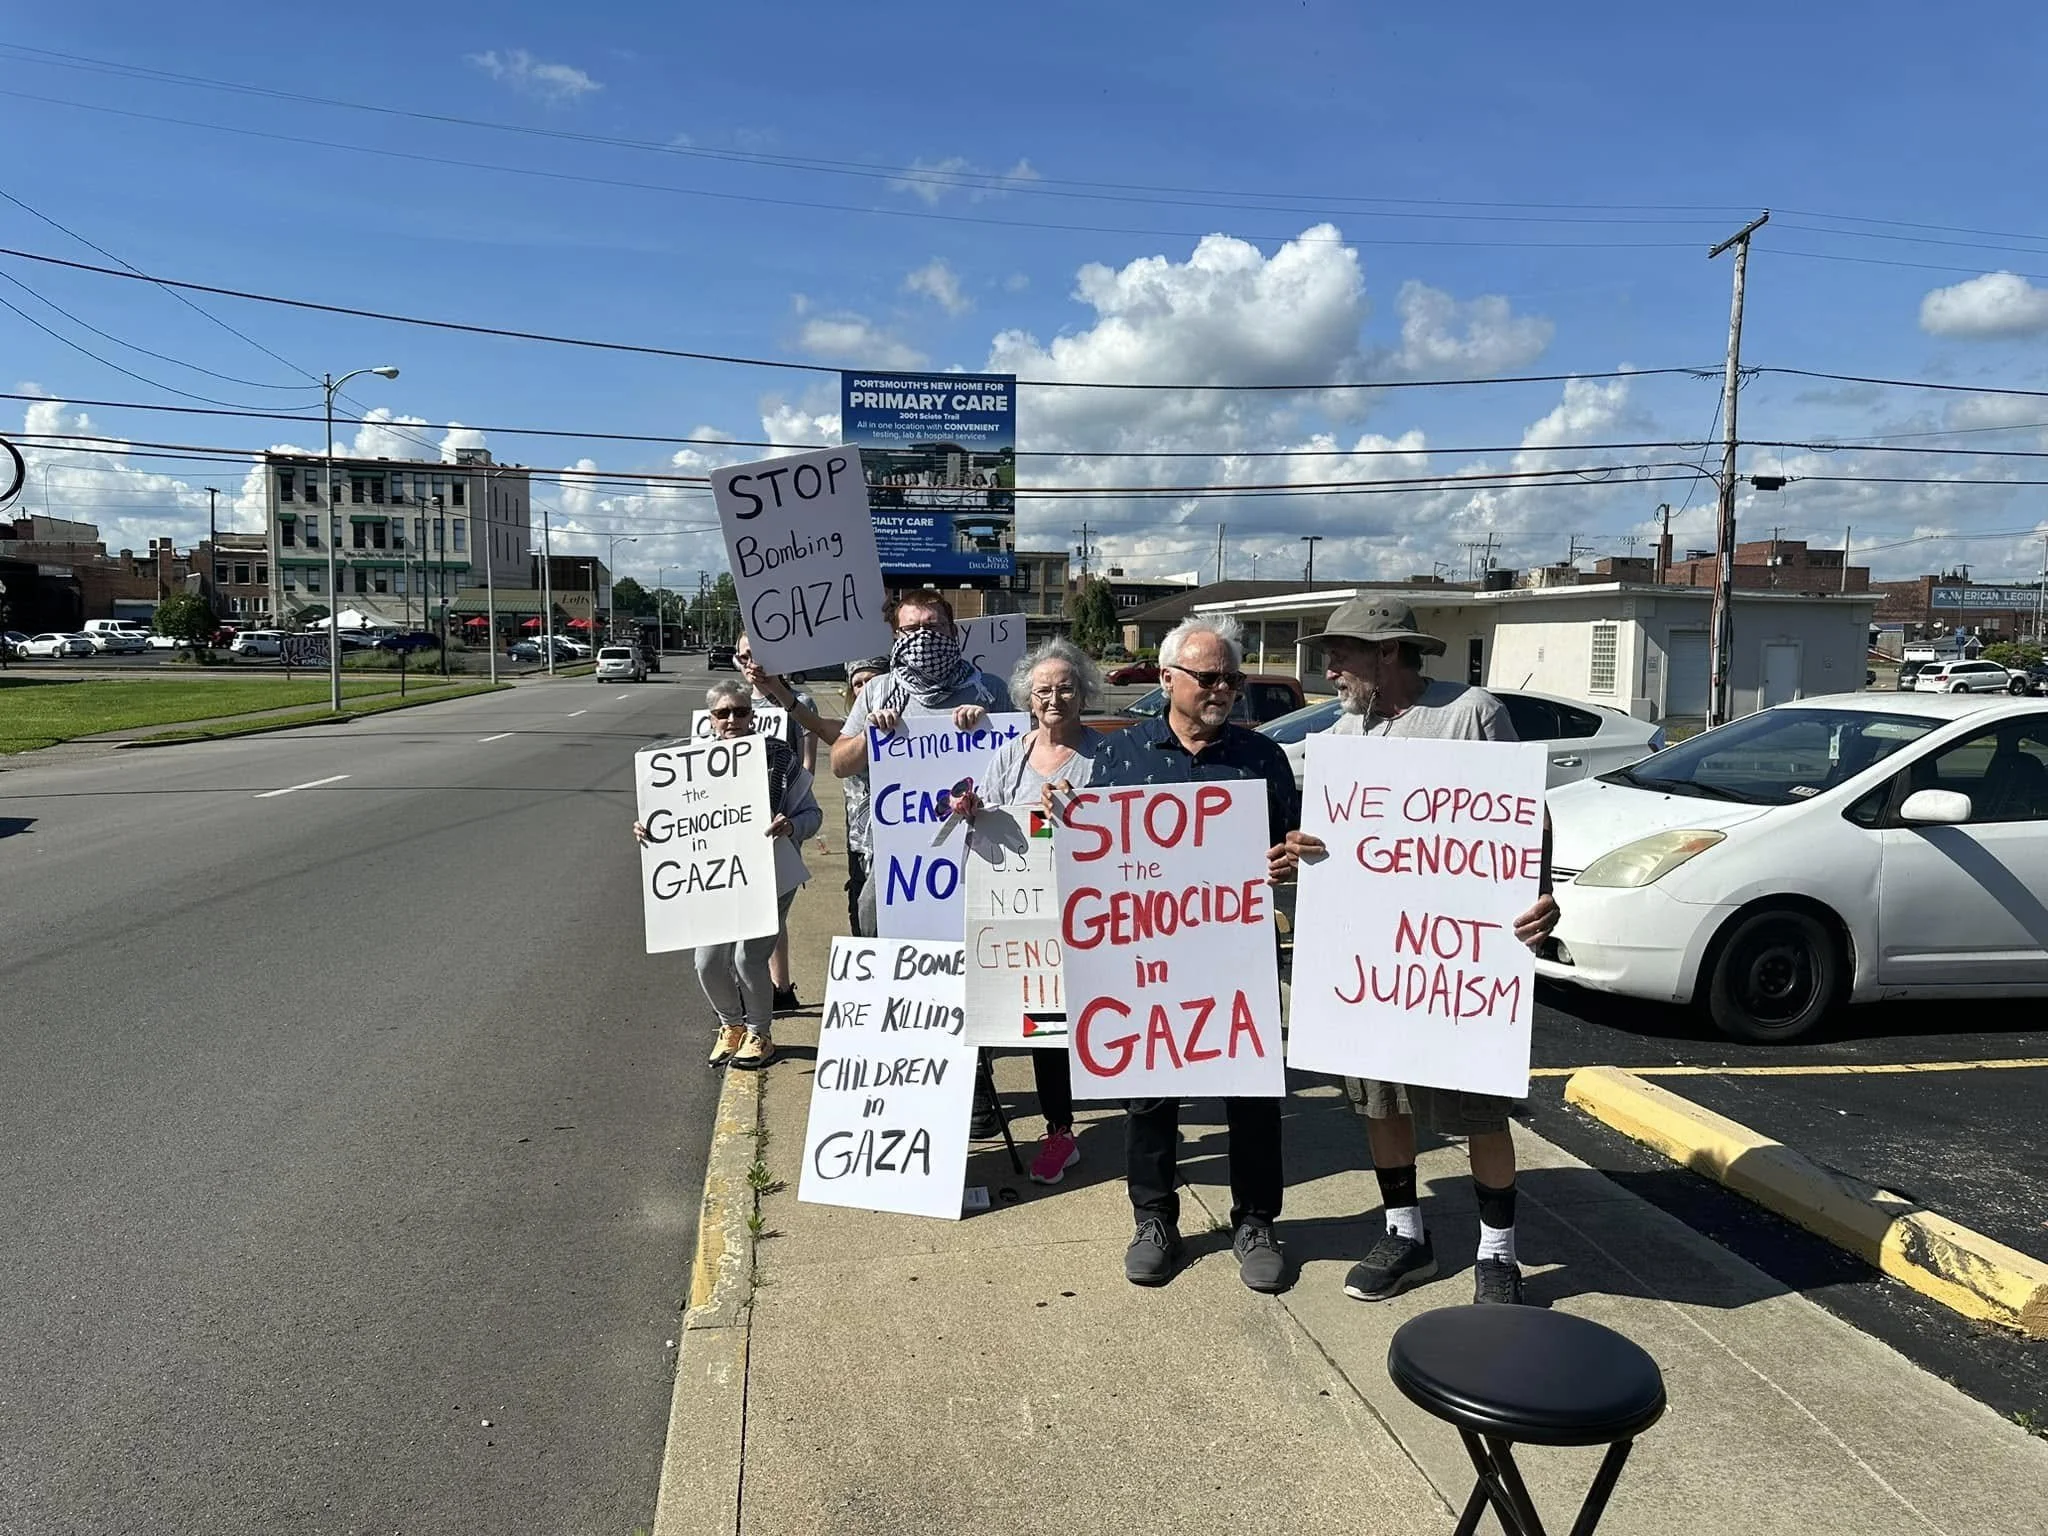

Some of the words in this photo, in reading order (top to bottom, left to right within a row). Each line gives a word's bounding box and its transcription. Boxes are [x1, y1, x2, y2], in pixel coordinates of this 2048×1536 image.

[849, 391, 947, 410] PRIMARY
[951, 394, 1008, 411] CARE
[854, 379, 929, 390] PORTSMOUTH'S
[930, 382, 952, 391] NEW
[954, 382, 983, 391] HOME
[984, 383, 1004, 391] FOR
[857, 420, 867, 428] All
[868, 421, 876, 429] in
[894, 421, 925, 430] location
[926, 422, 943, 430] with
[944, 423, 1000, 431] CONVENIENT
[899, 412, 918, 420] 2001
[943, 413, 960, 421] Trail
[902, 431, 914, 439] lab
[915, 431, 922, 439] &
[923, 431, 954, 441] hospital
[955, 432, 986, 440] services
[728, 457, 847, 520] STOP
[871, 517, 904, 526] CIALTY
[906, 517, 934, 526] CARE
[735, 529, 843, 578] Bombing
[751, 573, 864, 642] GAZA
[869, 724, 1020, 762] Permanent
[649, 741, 751, 788] STOP
[682, 788, 709, 804] the
[1324, 781, 1392, 823] WE
[1403, 787, 1537, 825] OPPOSE
[645, 804, 753, 844] GENOCIDE
[1062, 786, 1232, 862] STOP
[692, 838, 708, 852] in
[991, 844, 1031, 872] U.S.
[1356, 834, 1542, 884] GENOCIDE
[652, 855, 748, 901] GAZA
[1118, 861, 1162, 881] the
[991, 888, 1044, 917] NOT
[1062, 879, 1265, 950] GENOCIDE
[976, 927, 1062, 969] GENO
[1395, 911, 1503, 963] NOT
[1135, 955, 1168, 988] in
[1334, 954, 1520, 1025] JUDAISM
[1023, 975, 1059, 1009] !!!
[824, 1001, 872, 1029] ARE
[1075, 989, 1265, 1078] GAZA
[816, 1056, 949, 1091] CHILDREN
[862, 1095, 885, 1118] in
[814, 1127, 931, 1180] GAZA
